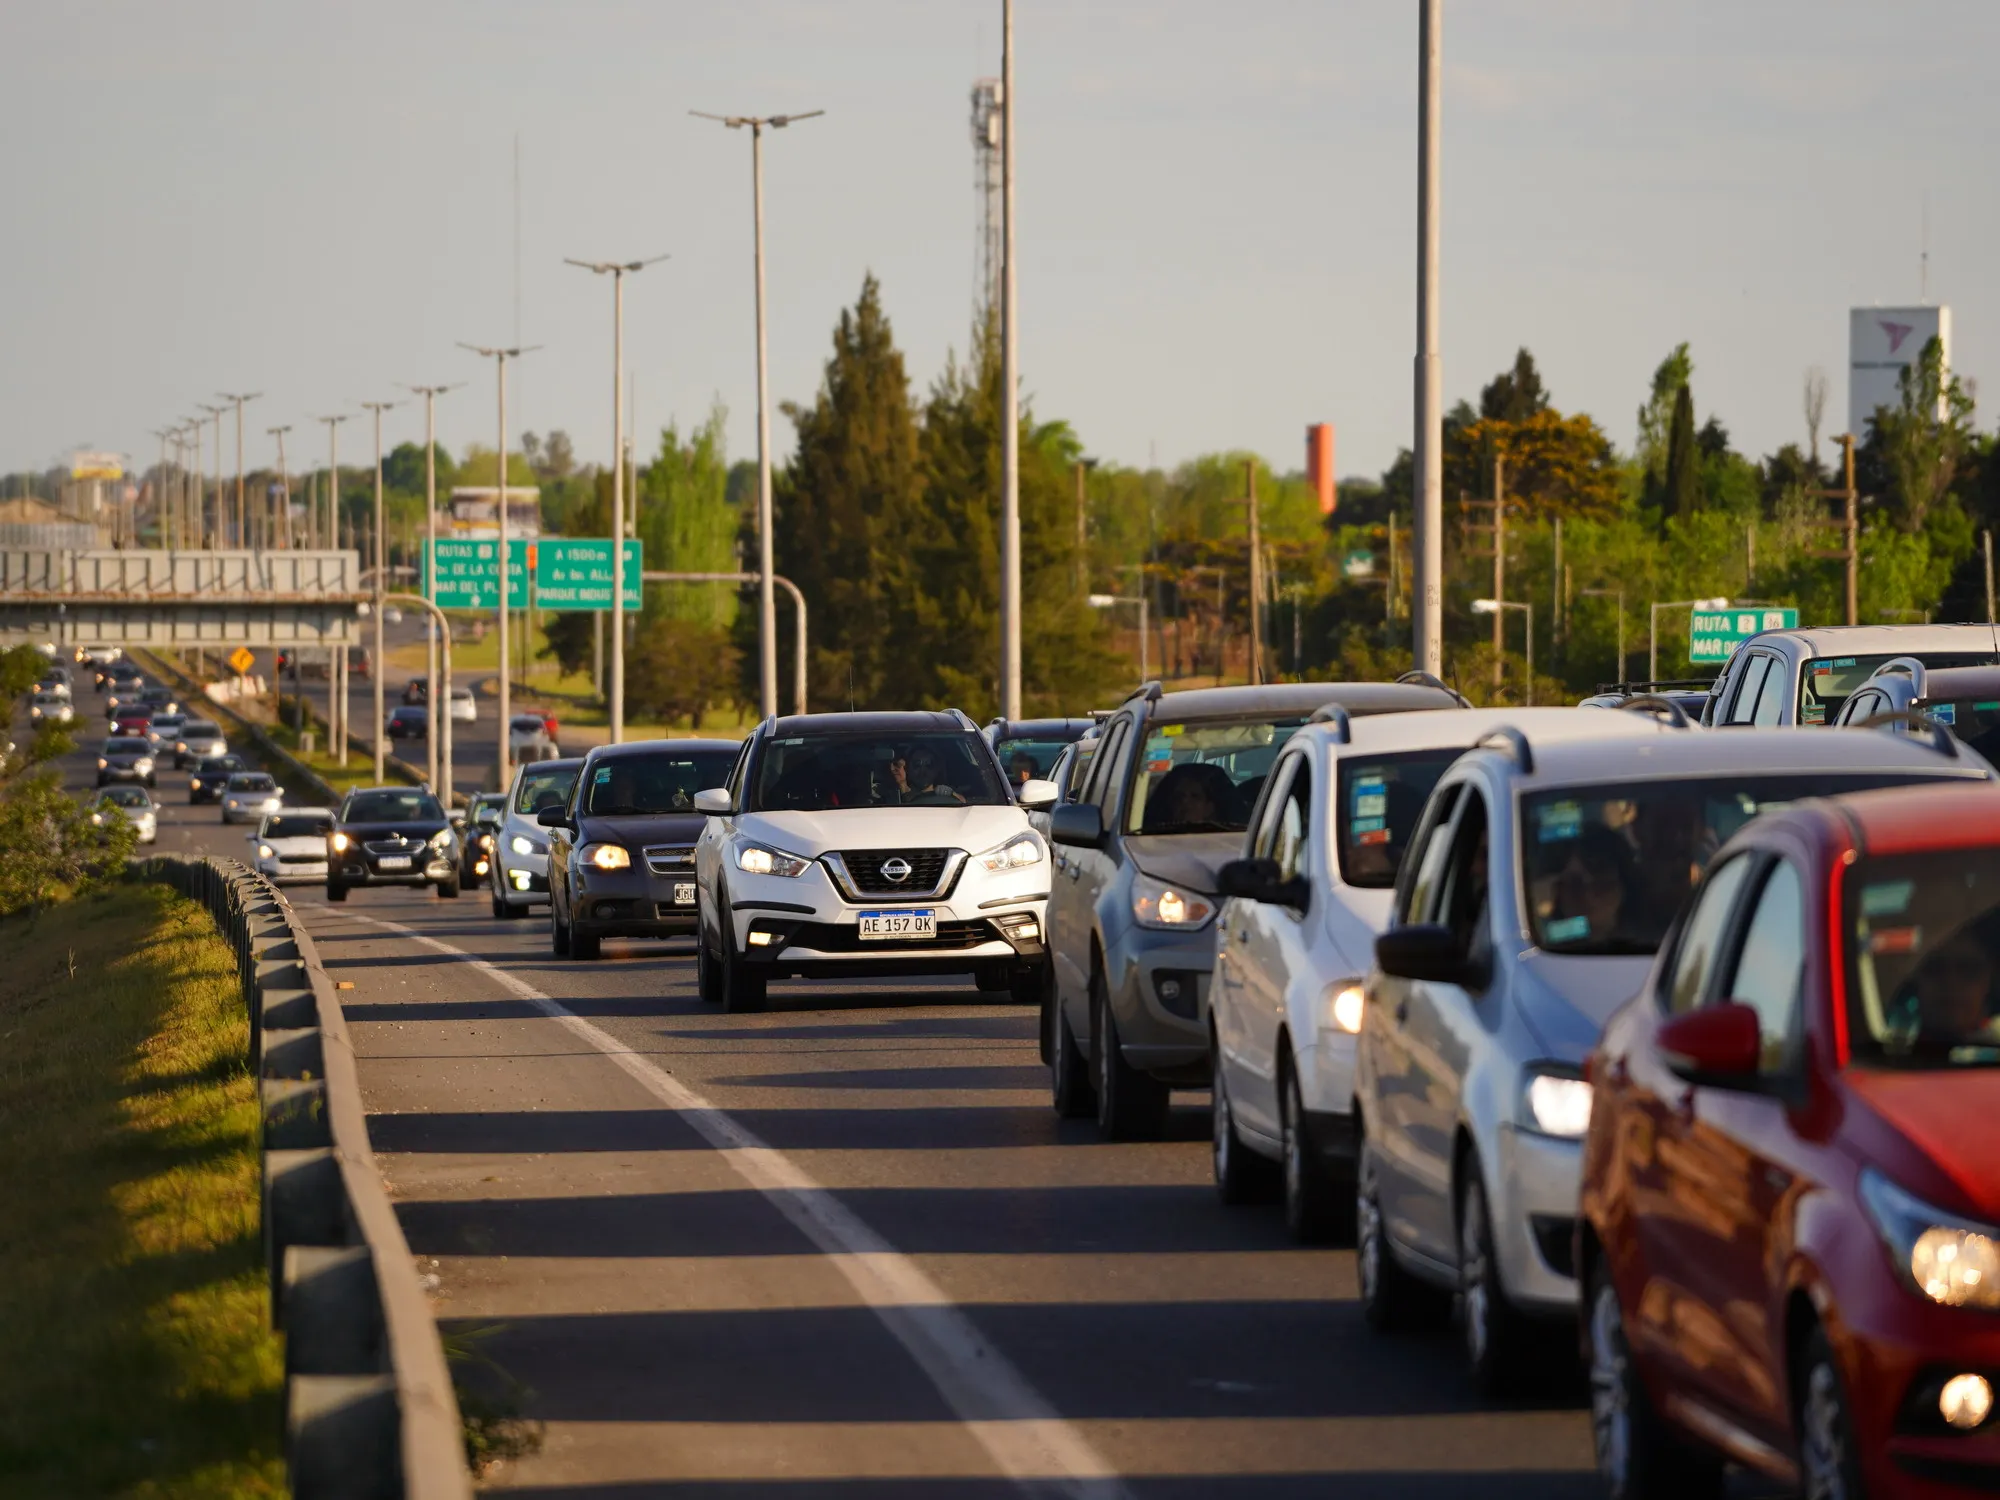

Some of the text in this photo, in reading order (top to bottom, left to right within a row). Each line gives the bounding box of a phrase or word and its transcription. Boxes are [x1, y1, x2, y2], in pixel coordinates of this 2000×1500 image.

[437, 544, 473, 558] RUTAS
[555, 548, 563, 560] A
[470, 564, 484, 576] LA
[460, 580, 479, 593] DEL
[1694, 615, 1731, 632] RUTA
[1693, 639, 1722, 655] MAR
[676, 888, 694, 900] JGU
[864, 917, 931, 932] AE 157 QK
